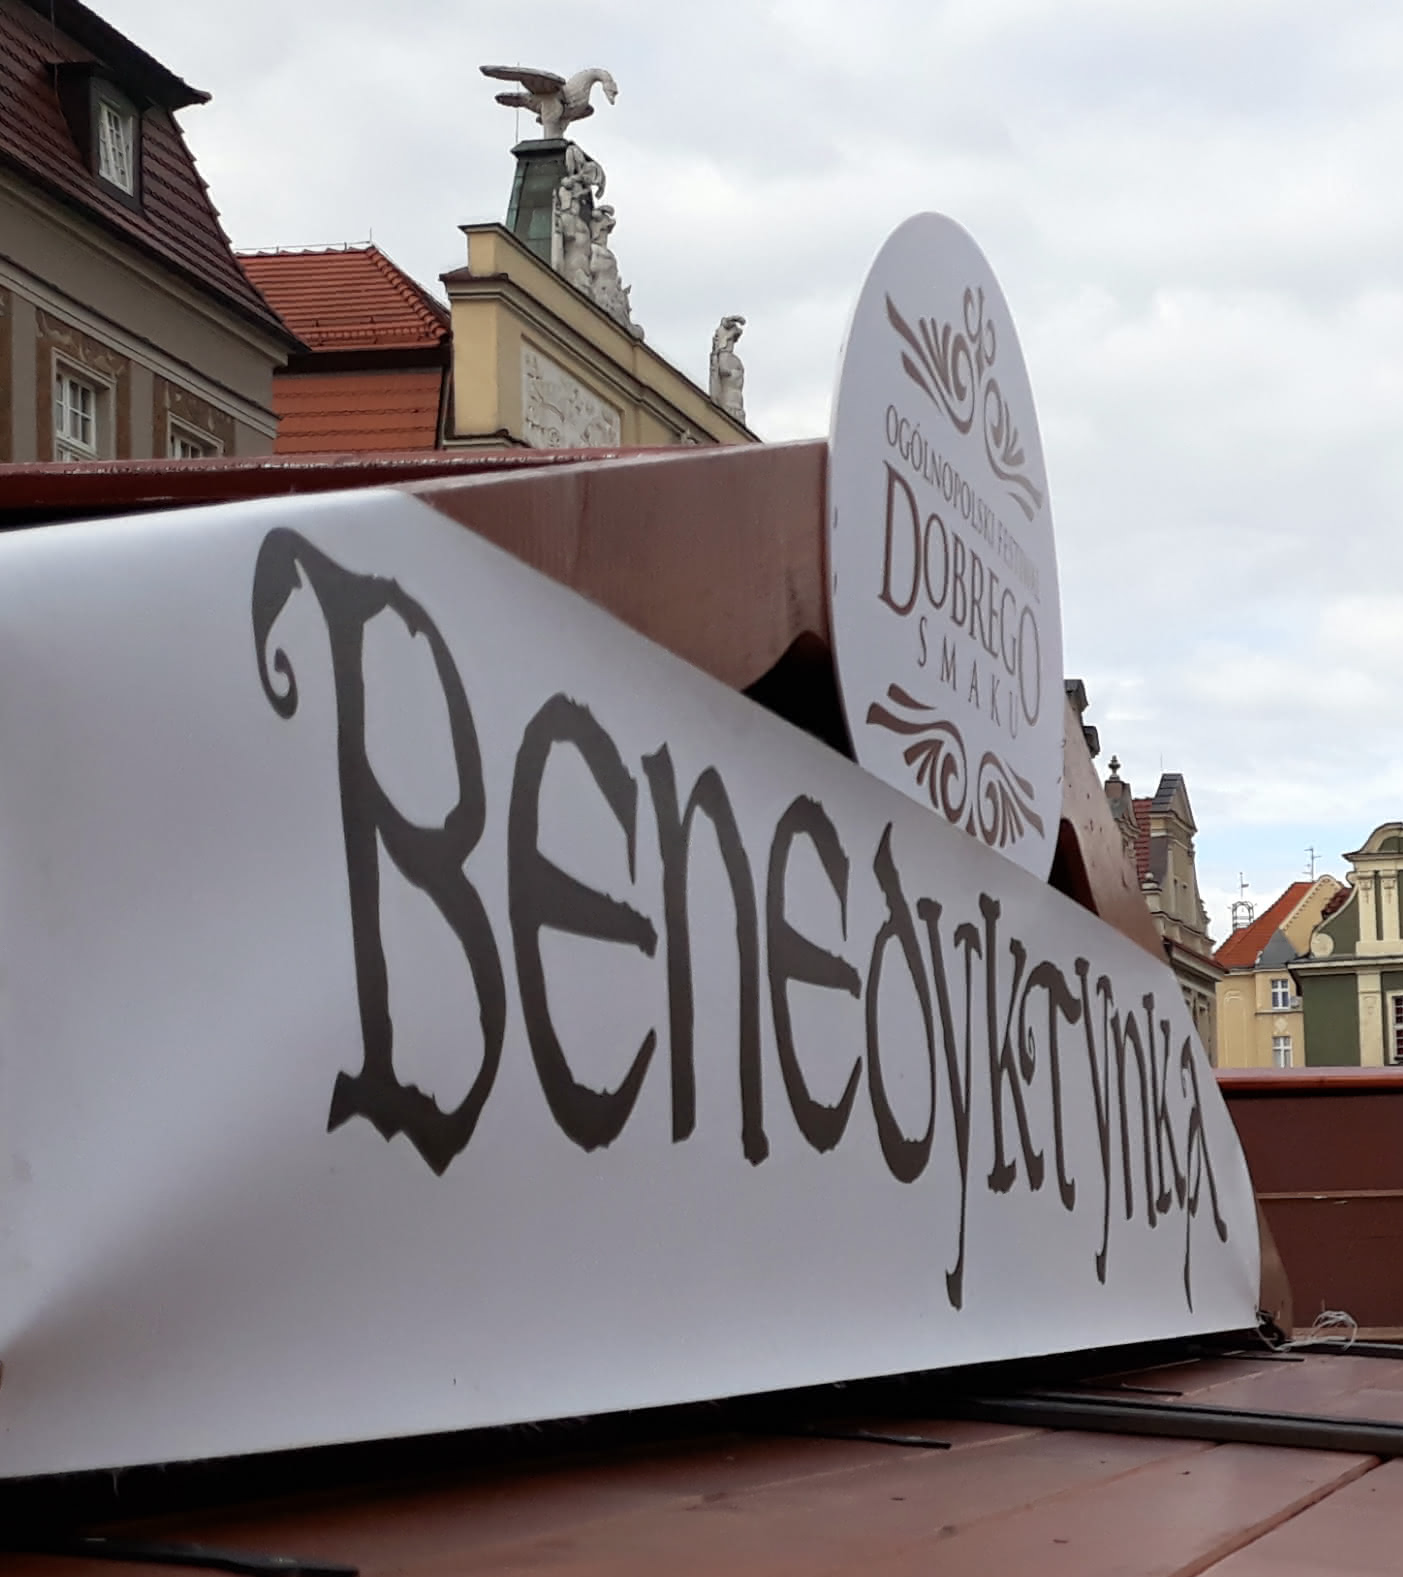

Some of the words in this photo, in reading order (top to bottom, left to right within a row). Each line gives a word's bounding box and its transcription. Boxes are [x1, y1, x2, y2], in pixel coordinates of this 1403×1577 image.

[886, 404, 996, 547] OGÓLNOPOLSKI
[877, 459, 1041, 727] DOBREGO
[916, 616, 1020, 740] SMAKU
